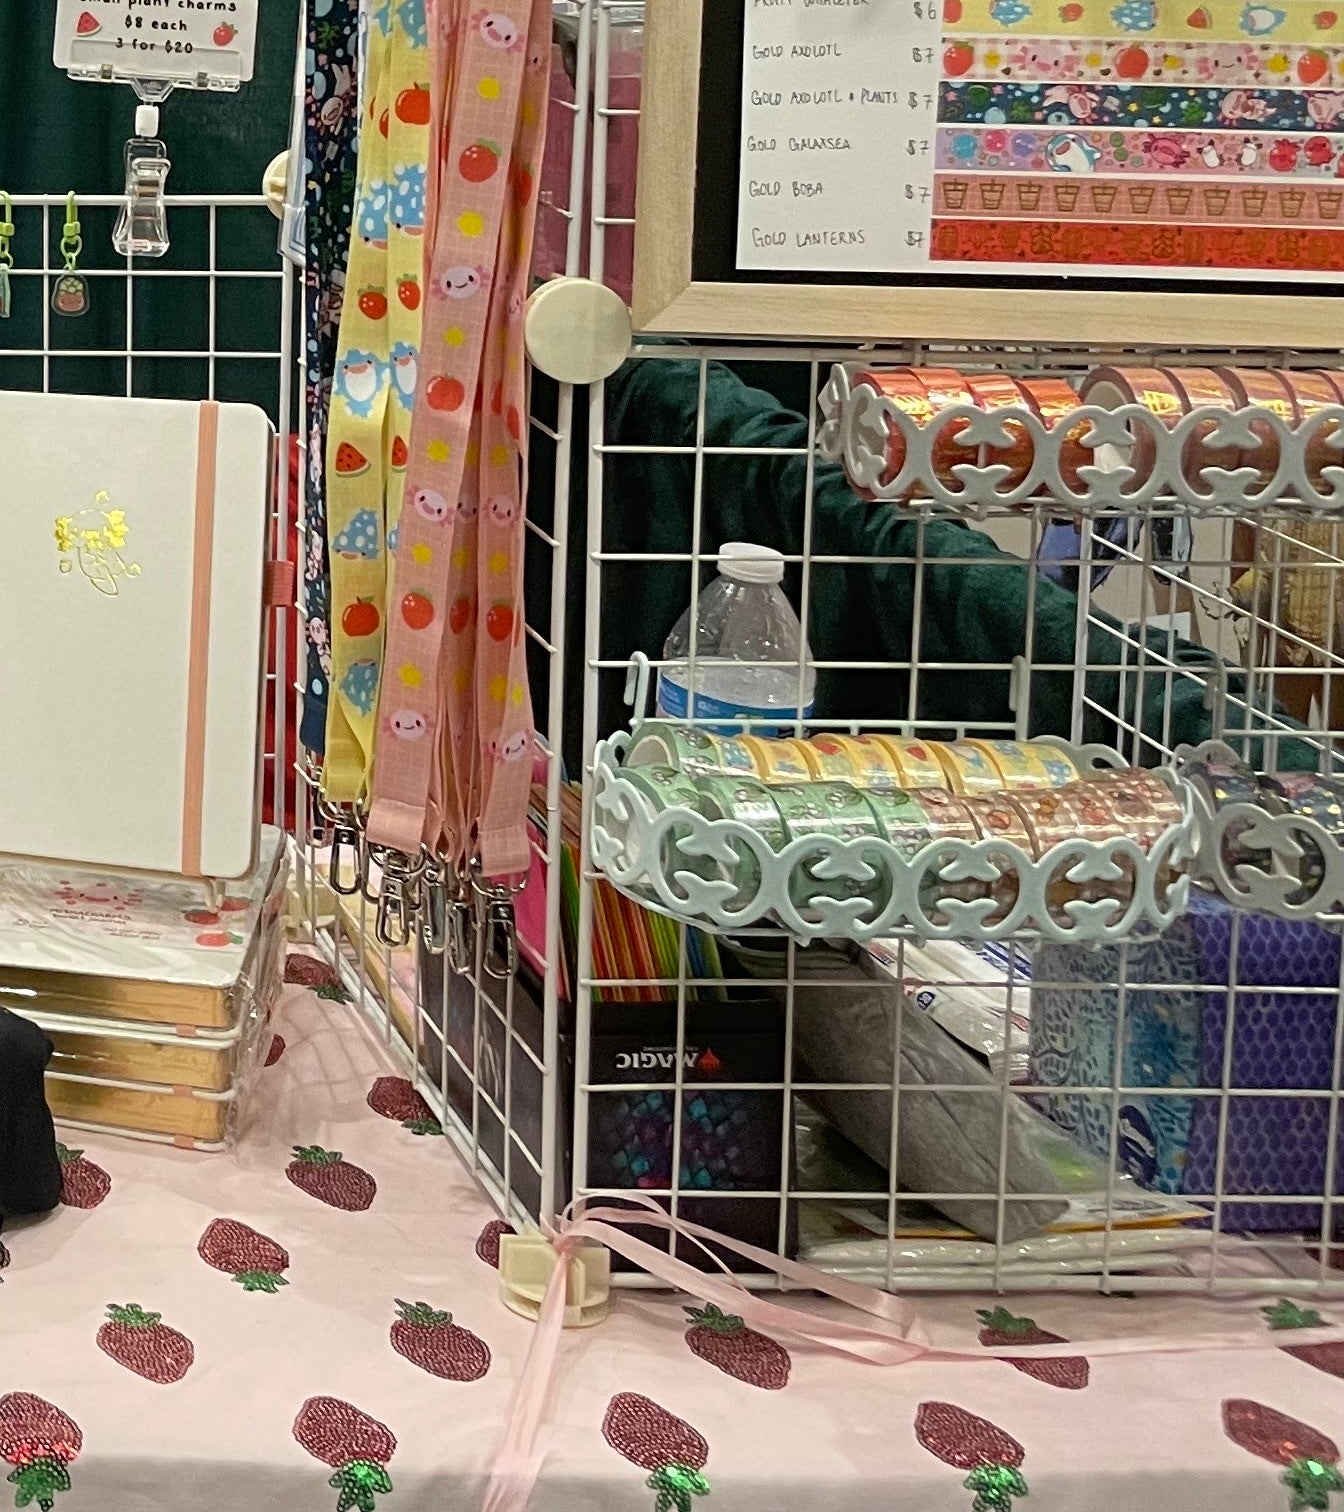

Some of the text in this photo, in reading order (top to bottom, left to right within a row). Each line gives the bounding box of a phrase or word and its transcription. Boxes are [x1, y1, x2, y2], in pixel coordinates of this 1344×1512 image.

[125, 14, 188, 32] $8 each
[115, 37, 193, 54] 3 for $20
[752, 44, 842, 59] GOLD AXOLOTL
[751, 89, 782, 107] GOLD
[861, 87, 898, 106] PLANTS
[747, 135, 777, 152] GOLD
[749, 181, 781, 197] GOLD
[752, 227, 866, 248] GOLD LANTERNS
[615, 1052, 700, 1069] MAGIC
